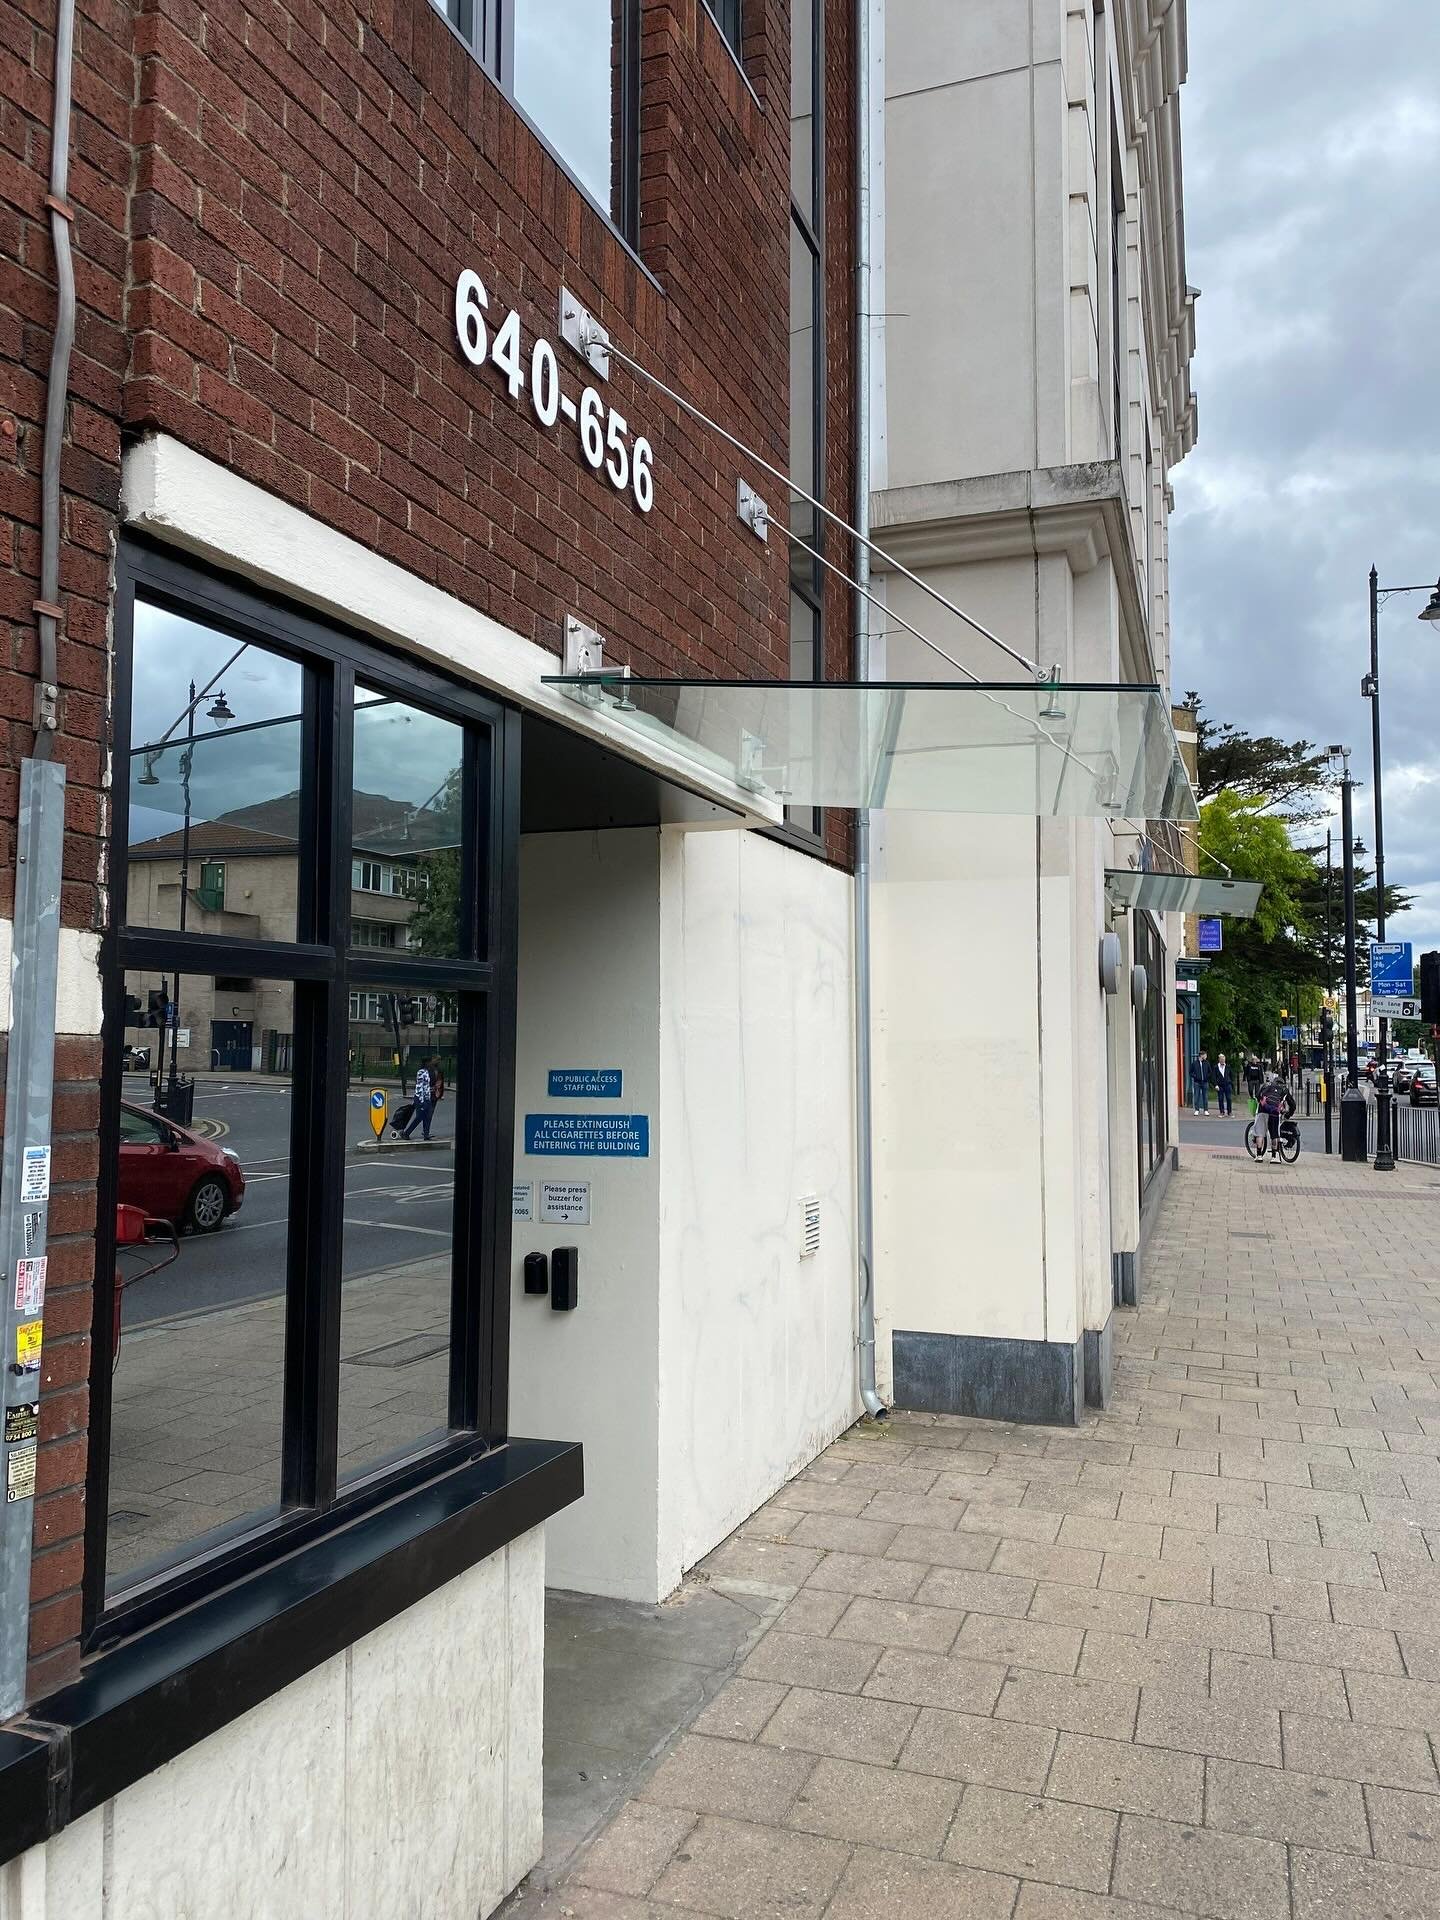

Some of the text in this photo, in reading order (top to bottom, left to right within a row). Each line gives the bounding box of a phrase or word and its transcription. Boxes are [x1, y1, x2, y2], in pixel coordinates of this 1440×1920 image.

[455, 268, 654, 513] 640-656
[552, 1075, 618, 1083] NO PUBLIC ACCESS
[586, 1084, 606, 1092] ONLY
[543, 1120, 630, 1129] PLEASE EXTINGUISH
[534, 1131, 640, 1140] ALL CIGARETTES BEFORE
[533, 1141, 640, 1151] ENTERING THE BUILDING
[544, 1185, 587, 1194] Please press
[547, 1204, 583, 1212] assistance
